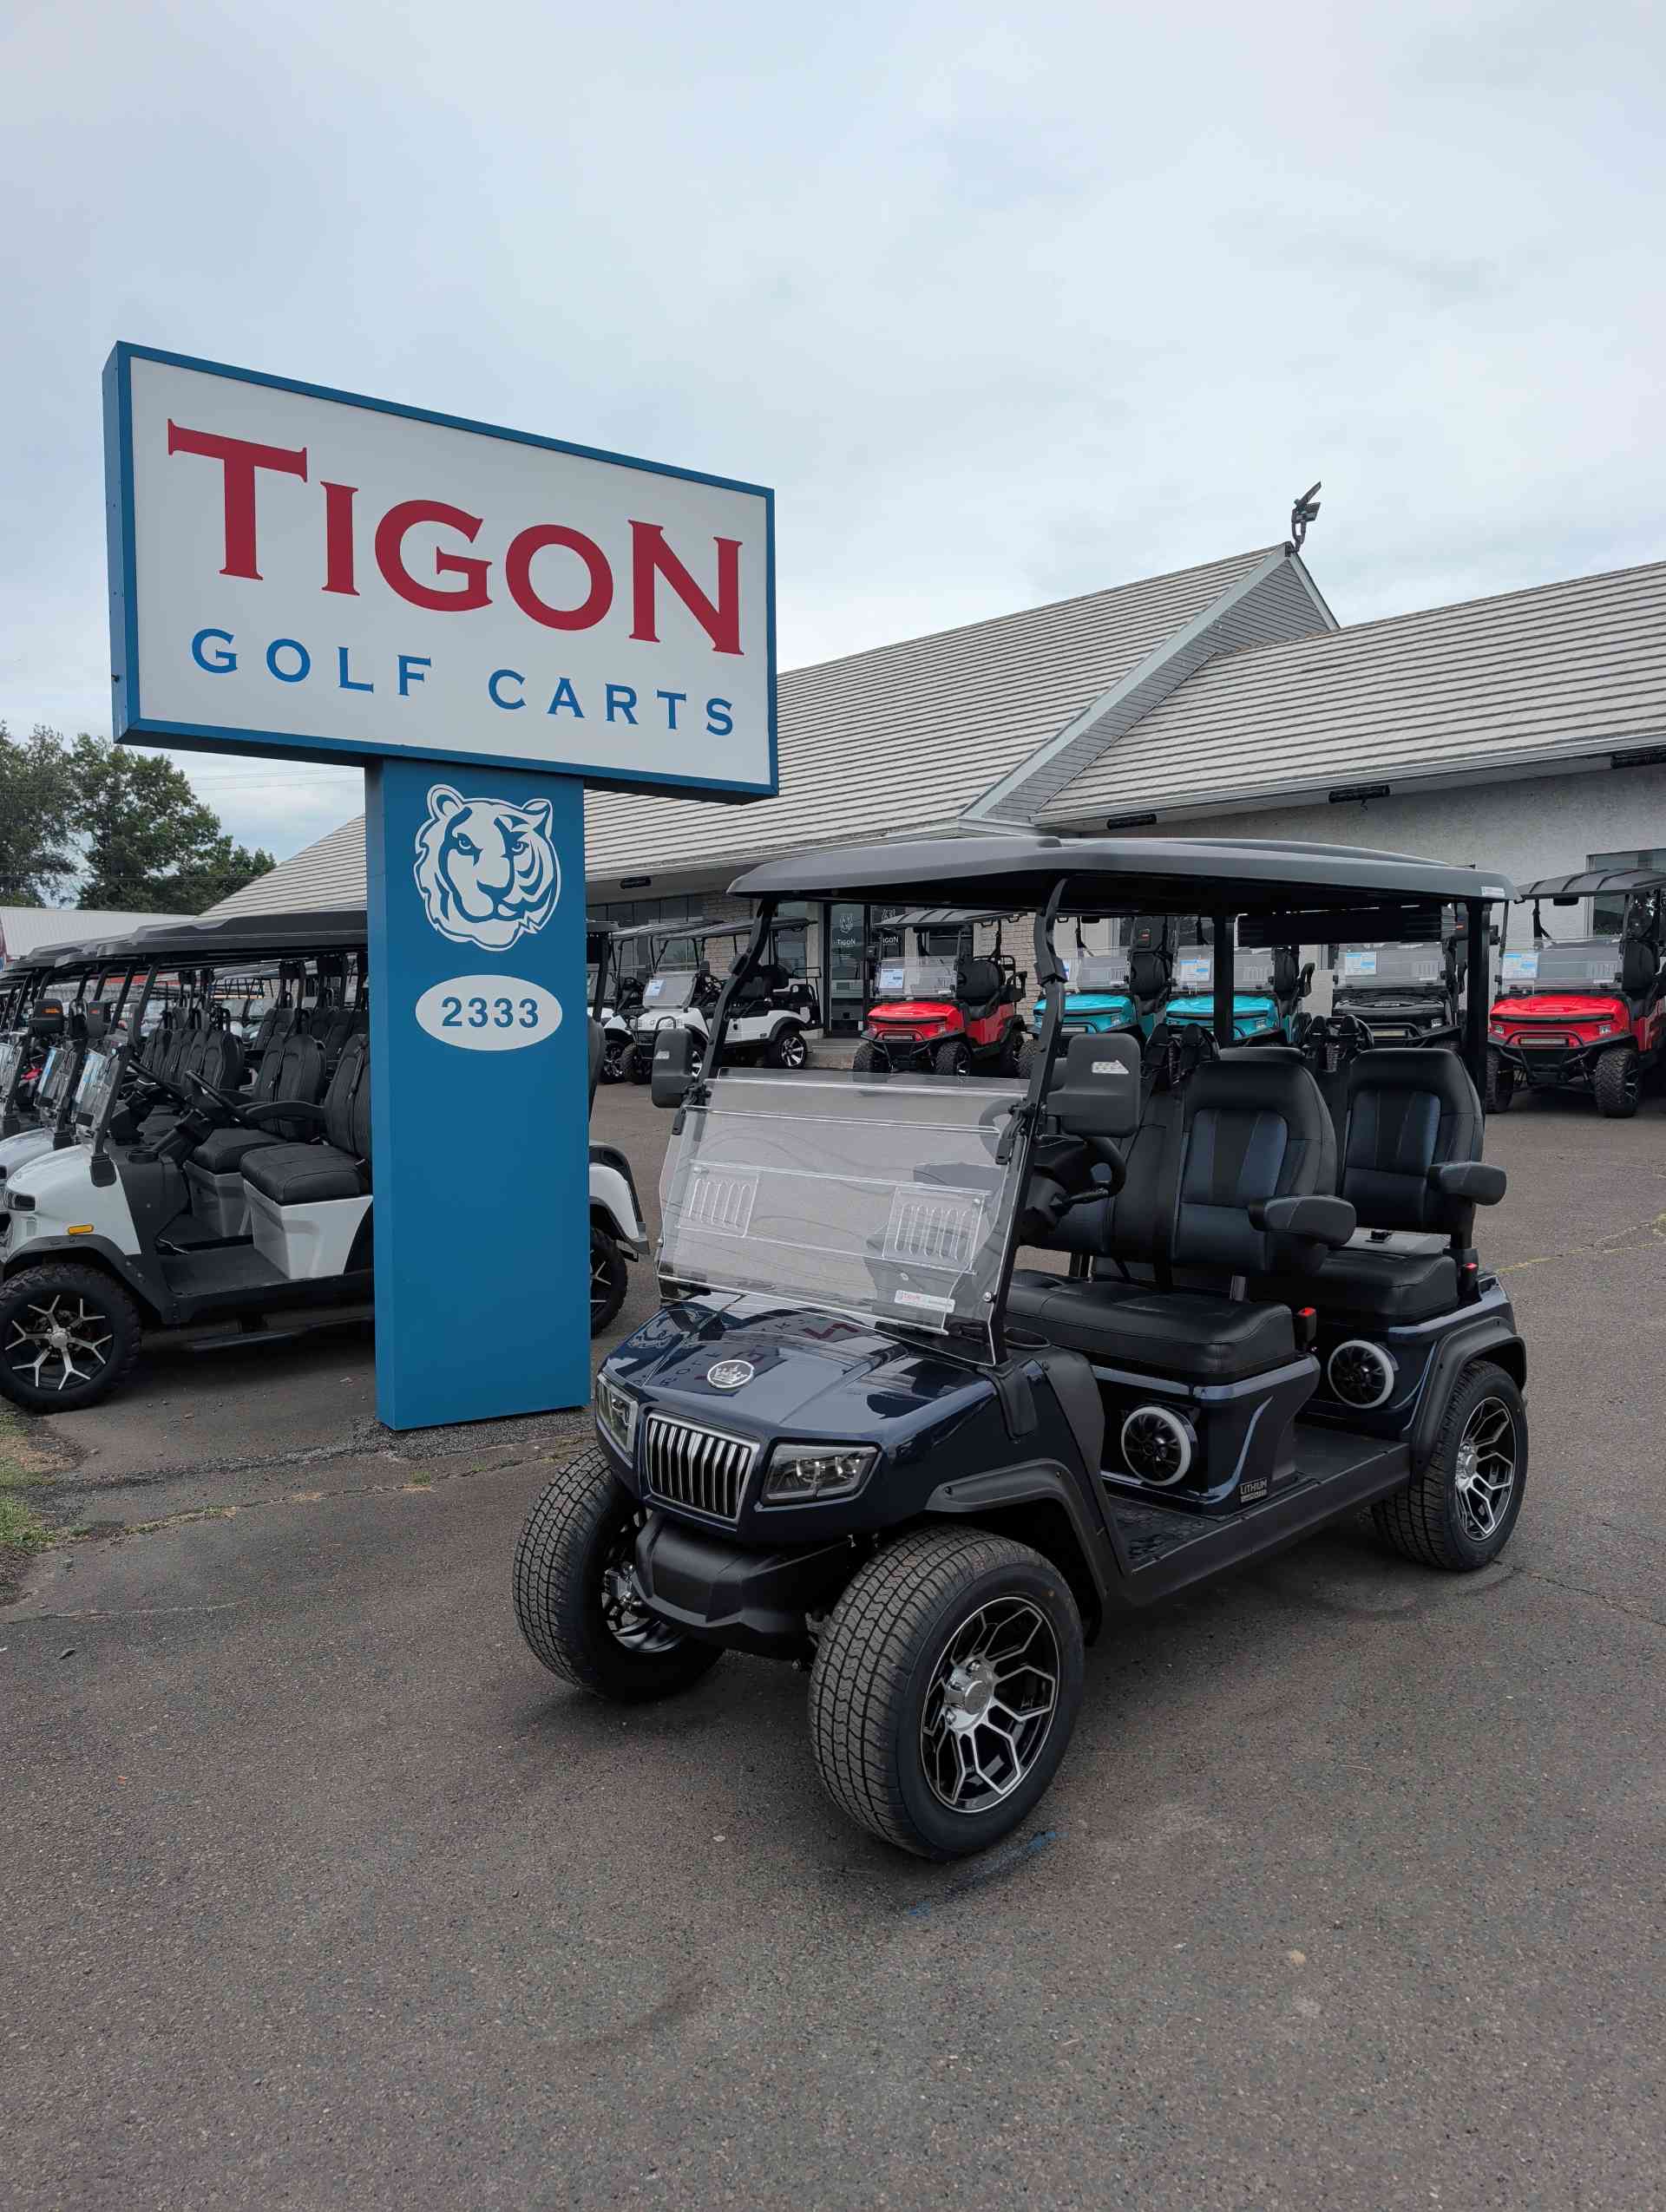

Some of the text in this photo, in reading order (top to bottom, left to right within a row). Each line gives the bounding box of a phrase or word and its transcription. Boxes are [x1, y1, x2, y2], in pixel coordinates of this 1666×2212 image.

[167, 418, 744, 656] TIGON
[191, 628, 734, 736] GOLF CARTS
[441, 996, 540, 1029] 2333
